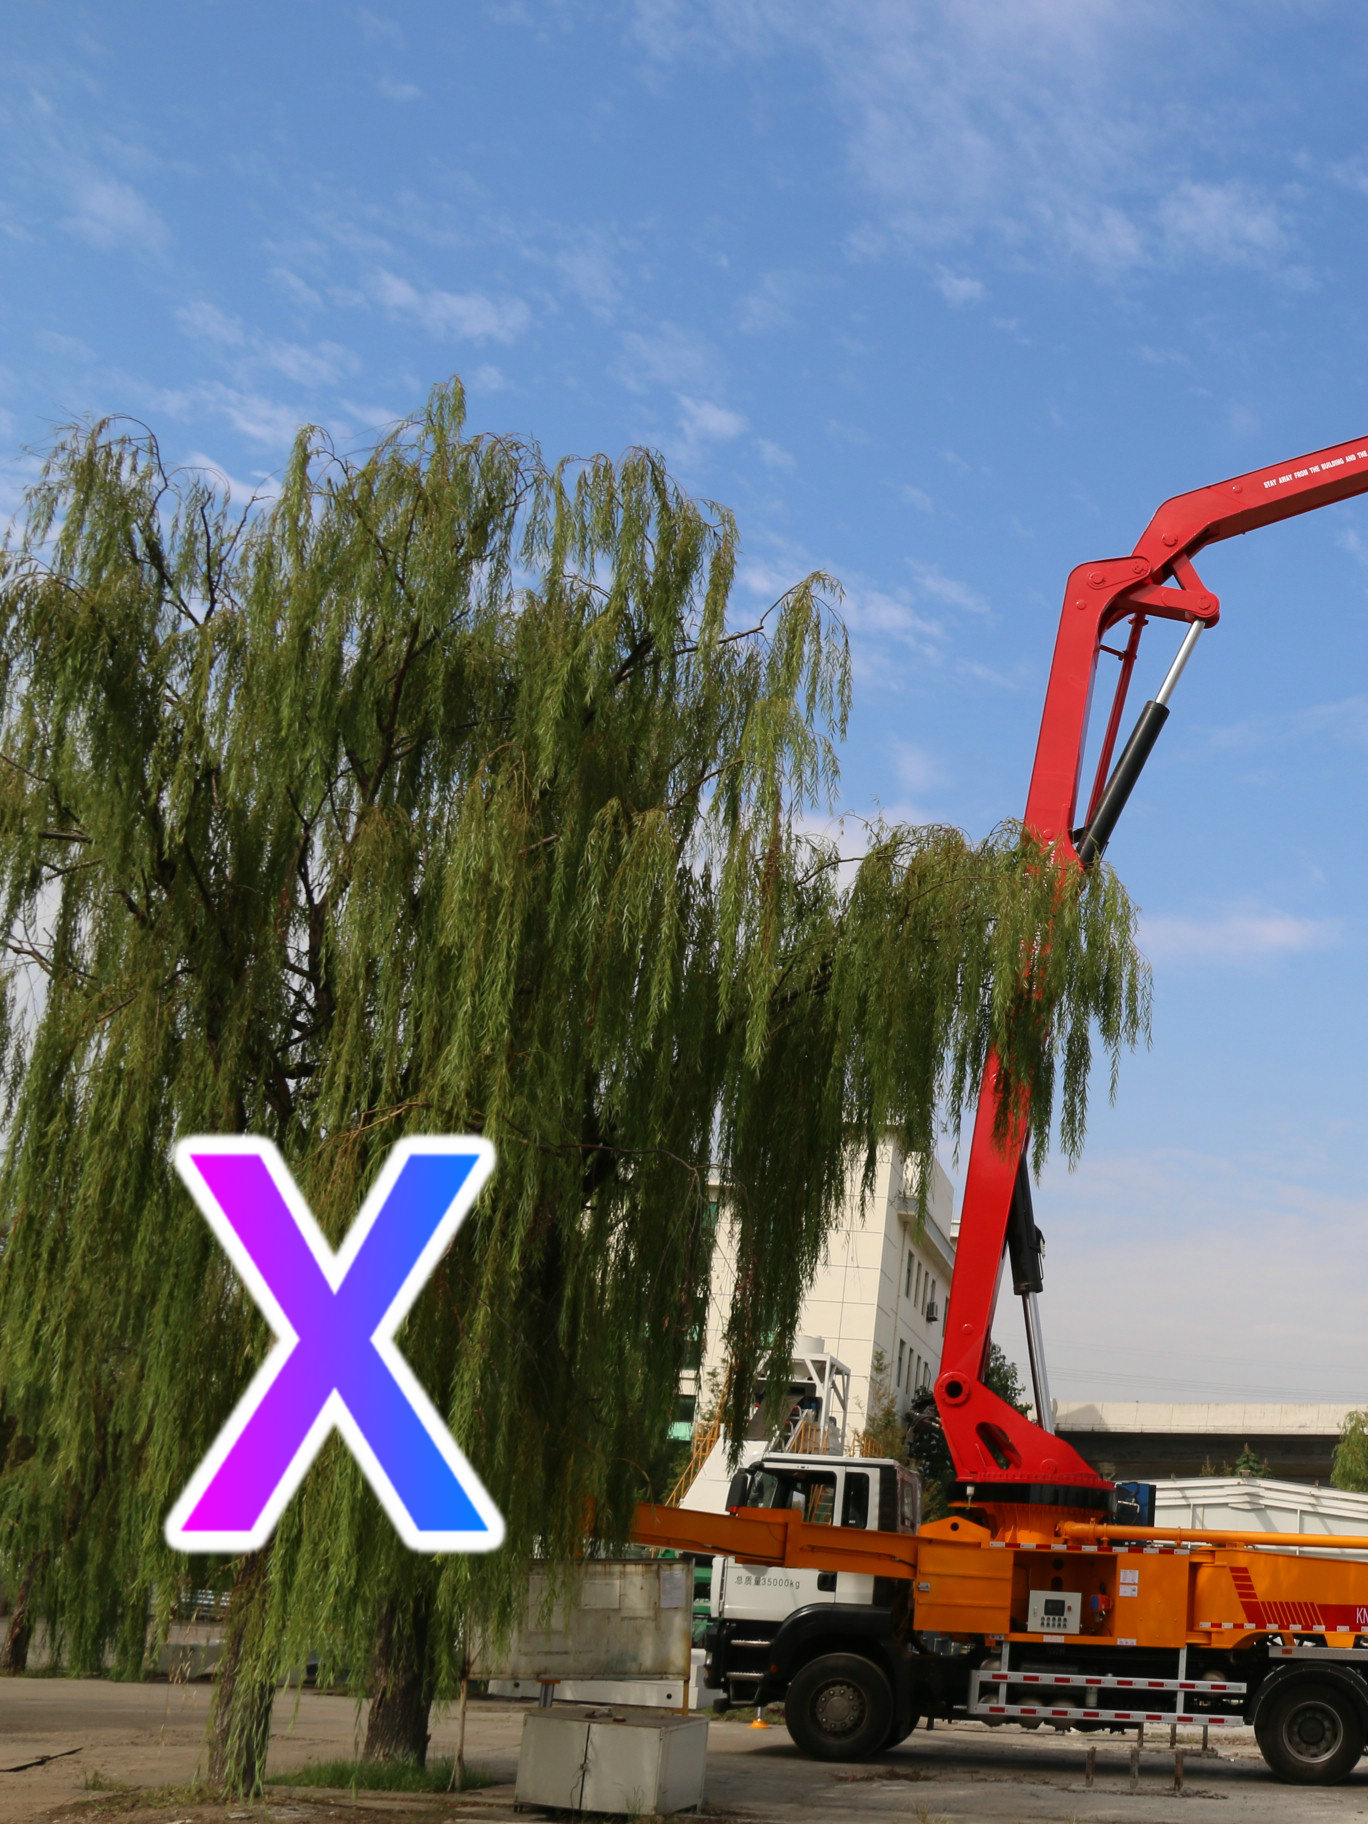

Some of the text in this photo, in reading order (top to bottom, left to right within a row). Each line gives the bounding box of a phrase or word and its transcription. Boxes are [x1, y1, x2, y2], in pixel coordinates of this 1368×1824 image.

[1263, 479, 1277, 489] STAY
[1278, 474, 1293, 484] AWAY
[1294, 469, 1309, 479] FROM
[1309, 465, 1321, 474] THE
[1321, 457, 1345, 471] BUILDING
[1345, 454, 1356, 463] AND
[1357, 450, 1368, 459] THE
[735, 1575, 800, 1590] 总质量35000kg
